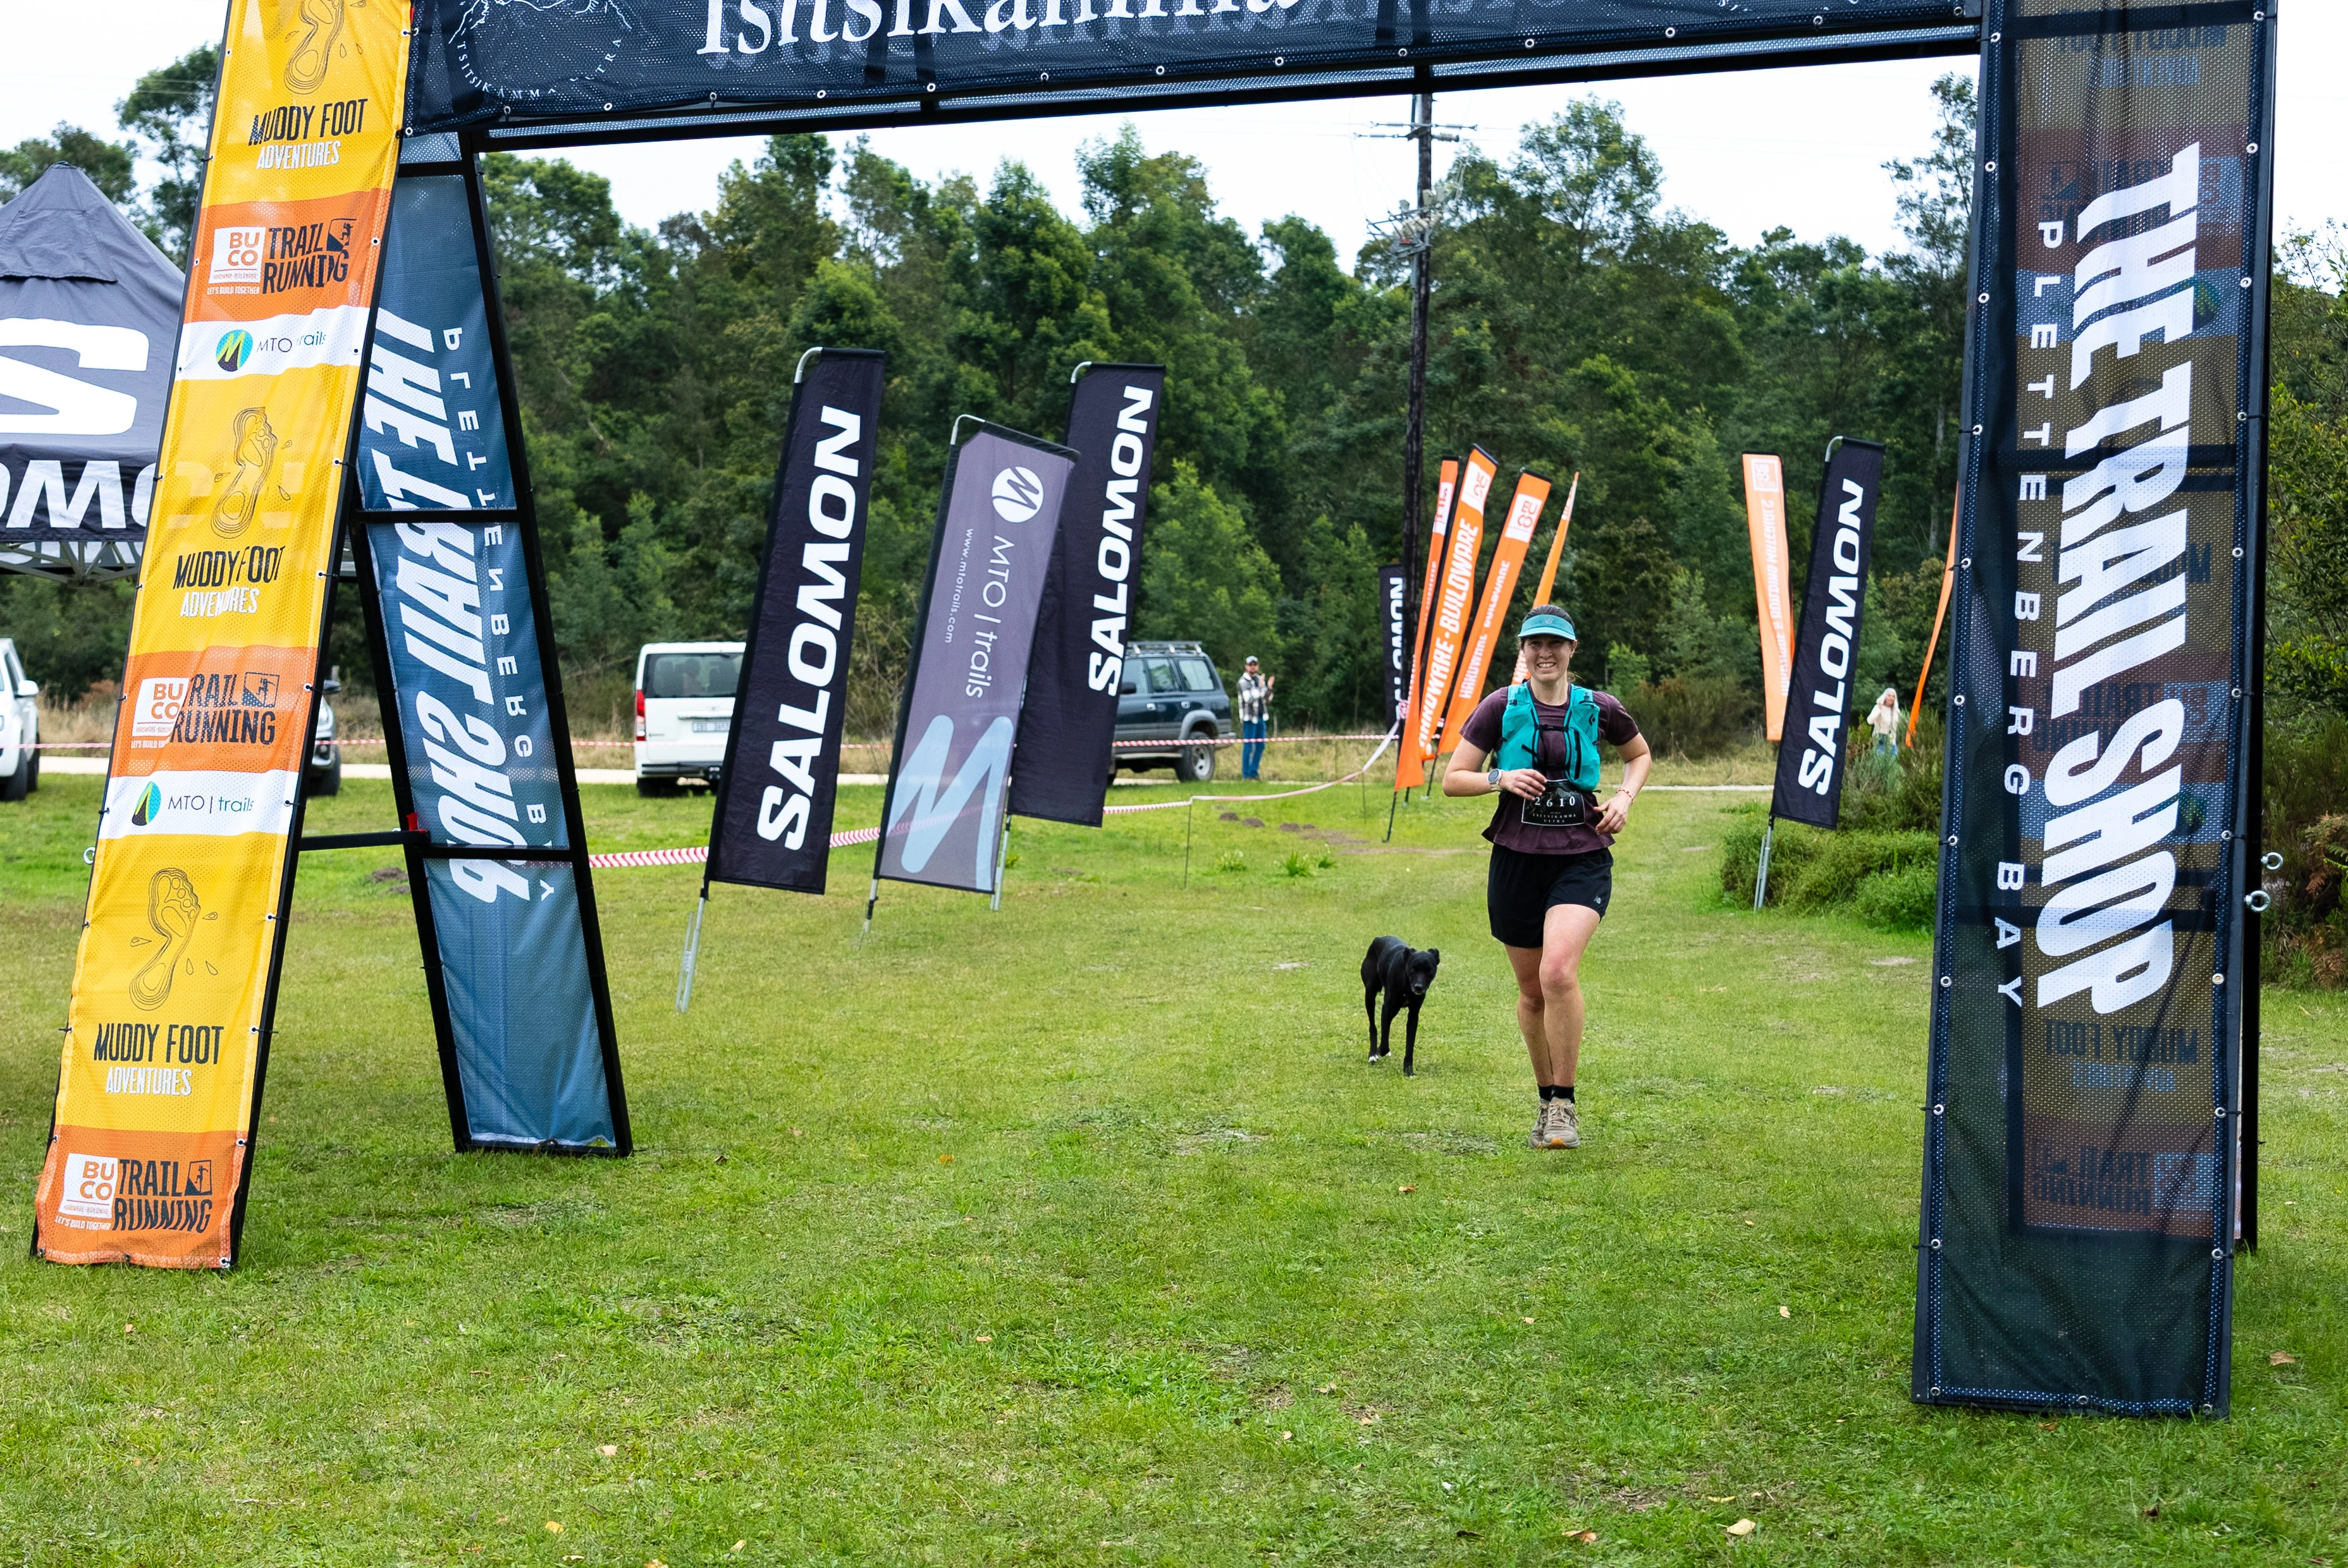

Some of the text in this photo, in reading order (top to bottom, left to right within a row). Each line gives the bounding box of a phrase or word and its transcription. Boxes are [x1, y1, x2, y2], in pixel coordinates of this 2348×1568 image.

[249, 99, 368, 145] MUDDY FOOT
[256, 140, 341, 169] ADVENTURES
[269, 223, 324, 259] TRAIL
[2070, 141, 2200, 391] THE
[257, 338, 293, 353] MTO
[1088, 385, 1153, 697] SALOMON
[2051, 360, 2192, 720] TRAIL
[173, 551, 240, 589] MUDDY
[945, 529, 974, 644] www.mtotrails.com
[757, 405, 861, 851] SALOMON
[965, 534, 1015, 698] MTO trails
[1995, 221, 2063, 1008] PLETTENBERG BAY
[1798, 479, 1864, 796] SALOMON
[169, 709, 276, 745] RUNNING
[168, 795, 204, 811] MTO
[1534, 796, 1575, 807] 2610
[2037, 698, 2185, 1015] SHOP
[94, 1023, 224, 1065] MUDDY FOOT
[106, 1067, 192, 1096] ADVENTURES
[119, 1159, 183, 1197] TRAIL
[112, 1199, 213, 1234] RUNNING
